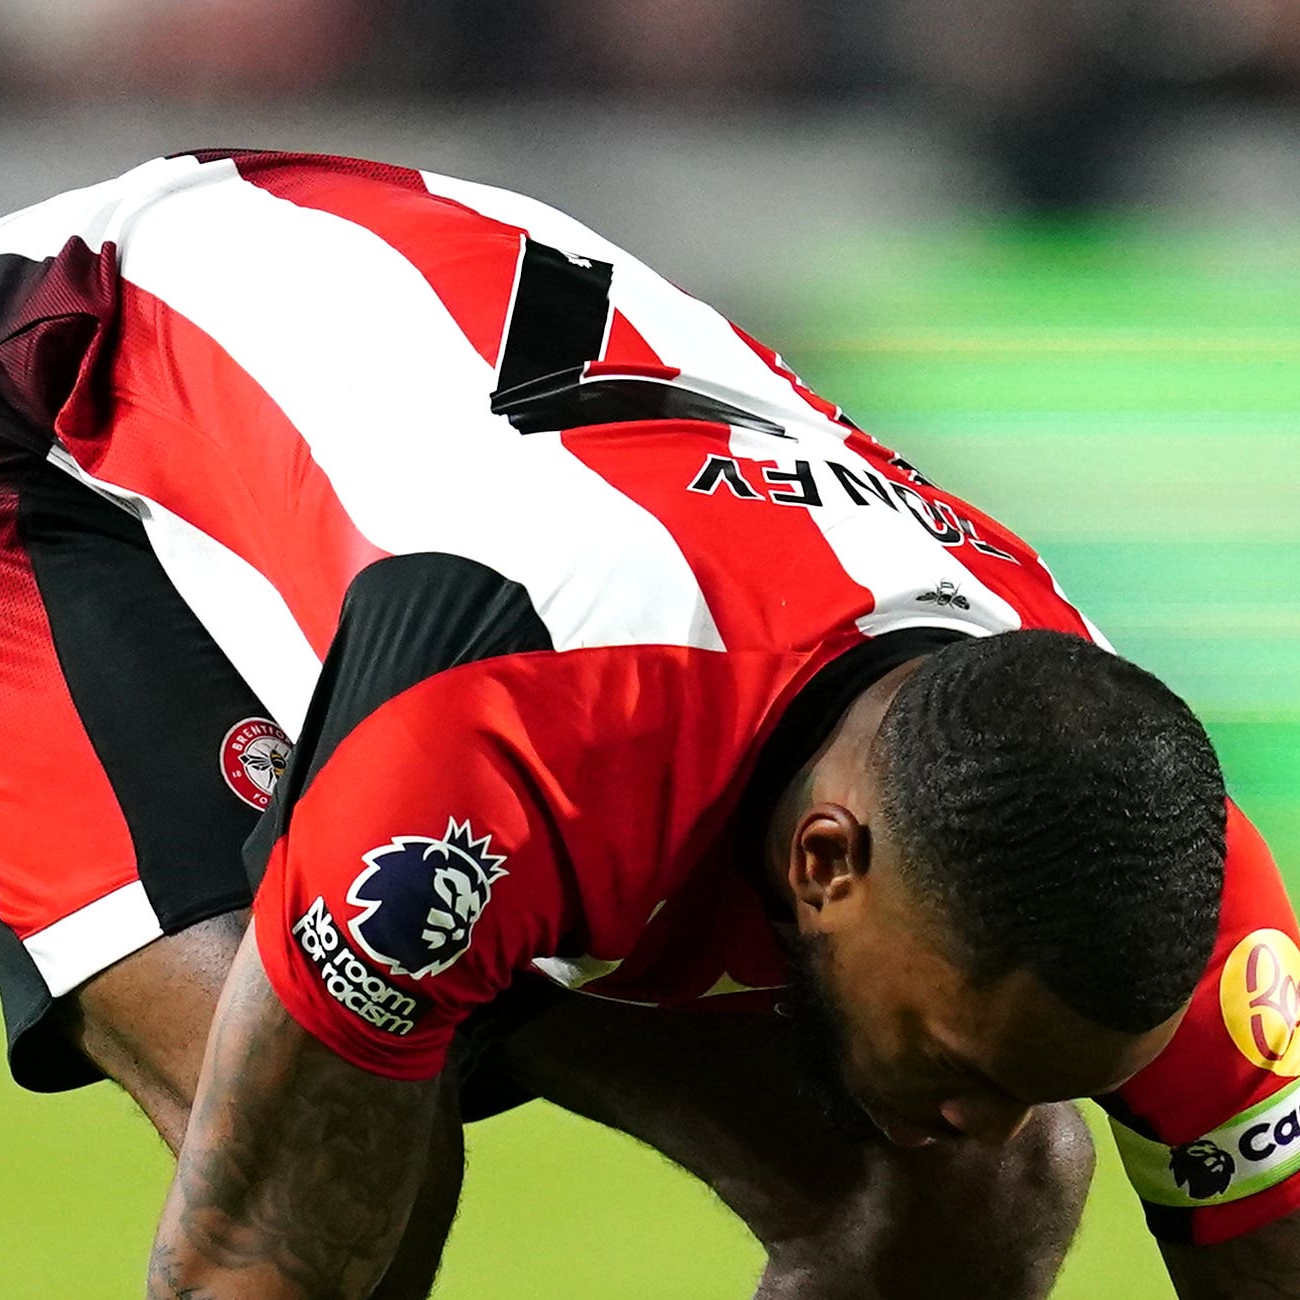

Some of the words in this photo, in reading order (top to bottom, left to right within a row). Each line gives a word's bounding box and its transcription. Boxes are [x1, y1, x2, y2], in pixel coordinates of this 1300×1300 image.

[308, 895, 339, 952] No
[333, 947, 416, 1016] room
[321, 962, 414, 1035] racism
